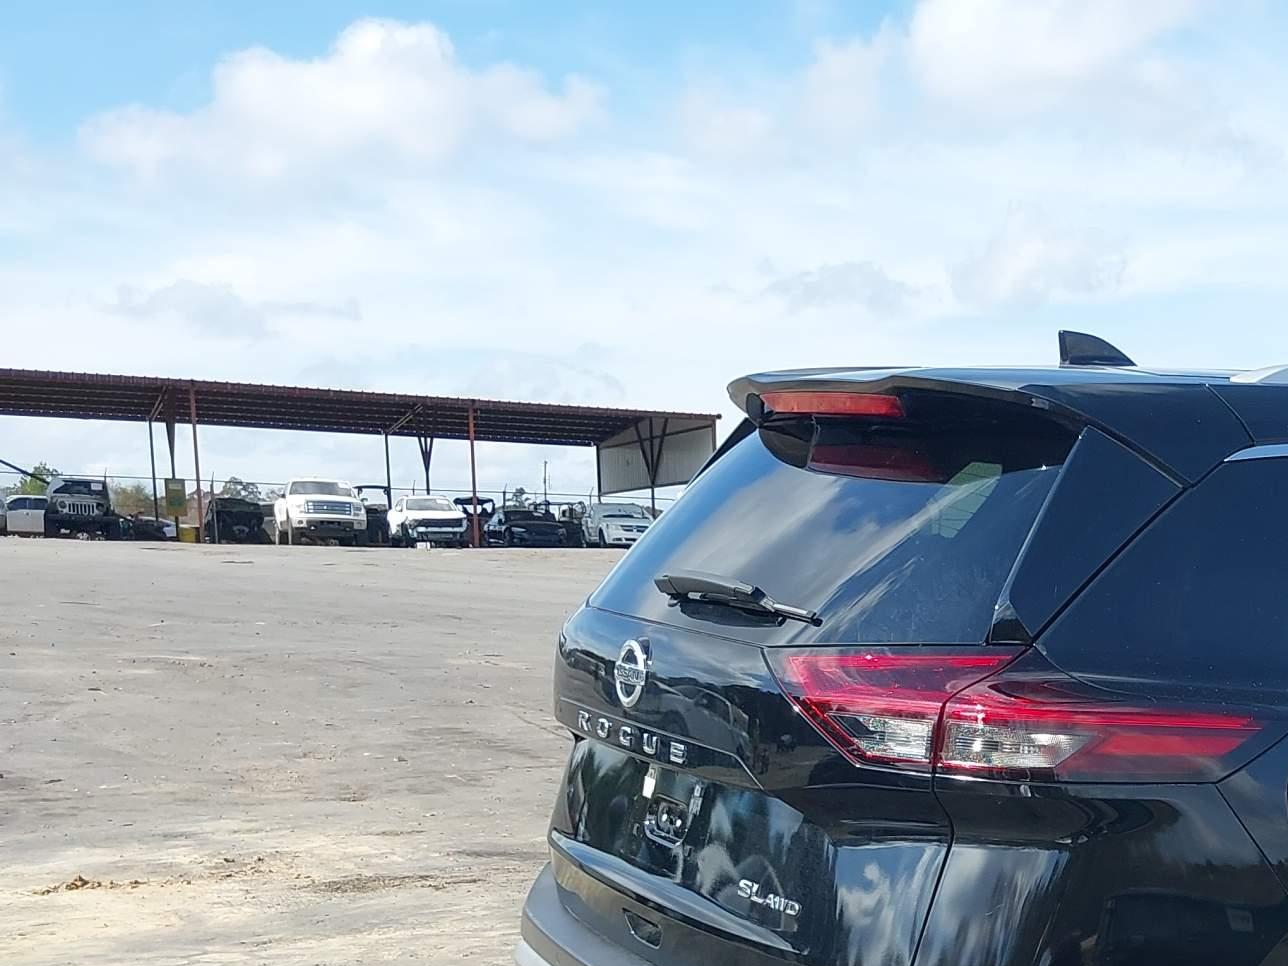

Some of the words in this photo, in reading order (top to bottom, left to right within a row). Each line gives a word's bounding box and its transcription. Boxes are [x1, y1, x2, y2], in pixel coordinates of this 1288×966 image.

[578, 710, 686, 764] ROGUE
[737, 879, 764, 904] SL
[764, 893, 802, 916] AWD
